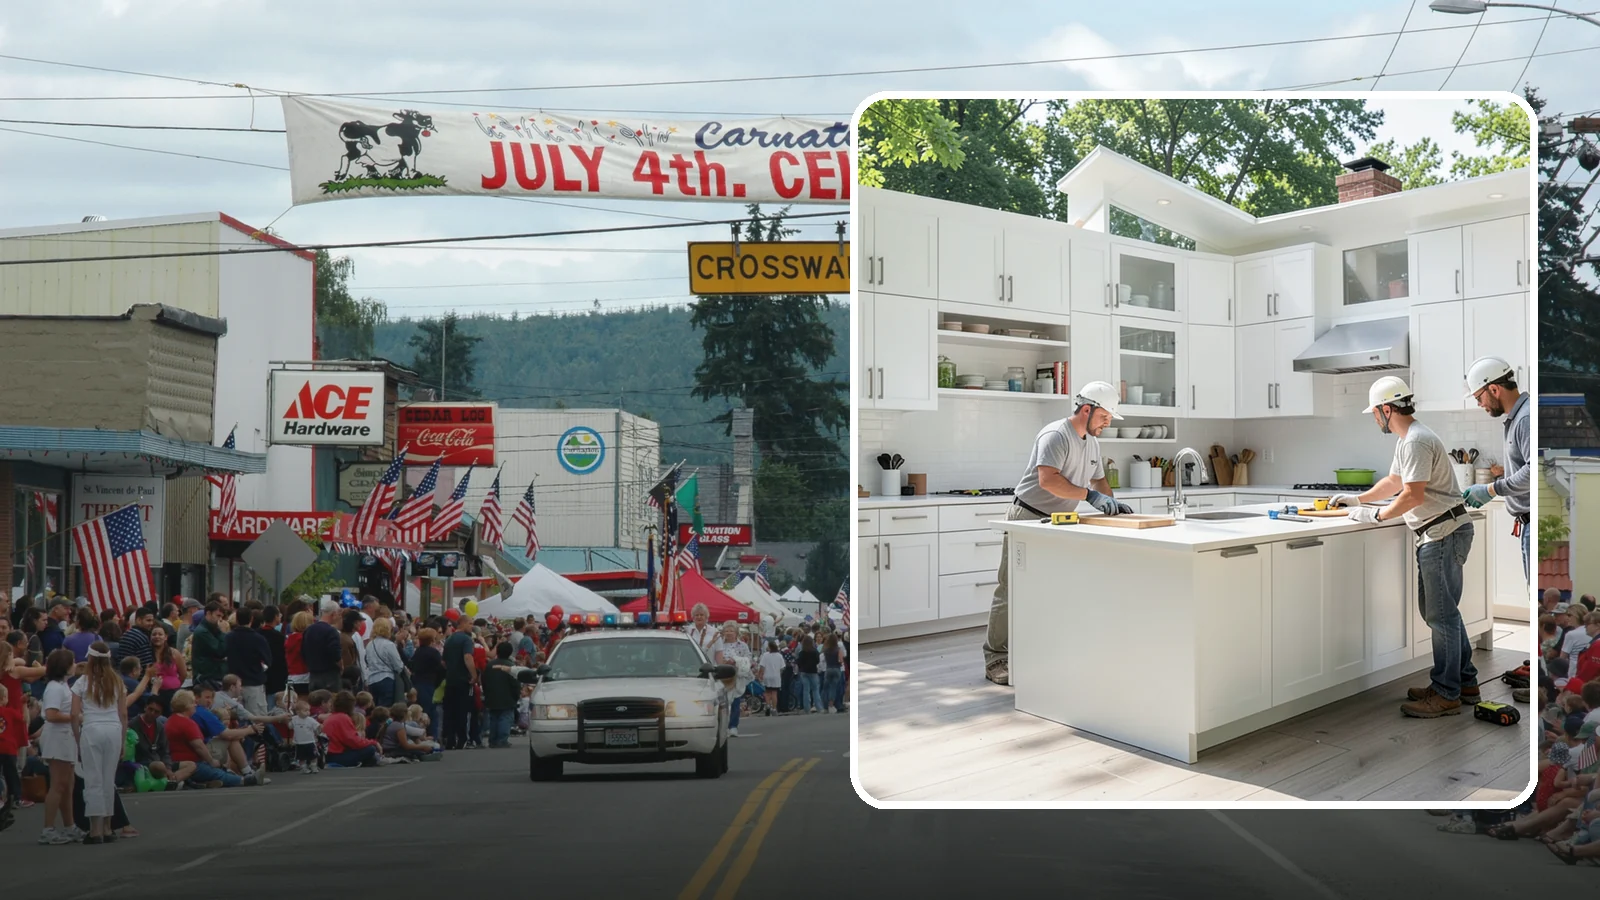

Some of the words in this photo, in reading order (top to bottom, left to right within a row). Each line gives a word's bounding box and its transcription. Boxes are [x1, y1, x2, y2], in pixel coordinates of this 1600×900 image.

[481, 141, 605, 192] JULY
[632, 150, 746, 198] 4th.
[697, 254, 850, 280] CROSSWA
[283, 380, 373, 419] ACE
[405, 409, 452, 422] CEDAR
[461, 409, 485, 421] LOG
[283, 421, 371, 436] Hardware
[353, 467, 385, 481] Simpl
[96, 485, 124, 495] Vincent
[126, 485, 135, 494] de
[137, 486, 155, 495] Paul
[212, 516, 330, 536] HARDARE
[688, 526, 741, 535] CRNATION
[699, 535, 730, 543] GLASS
